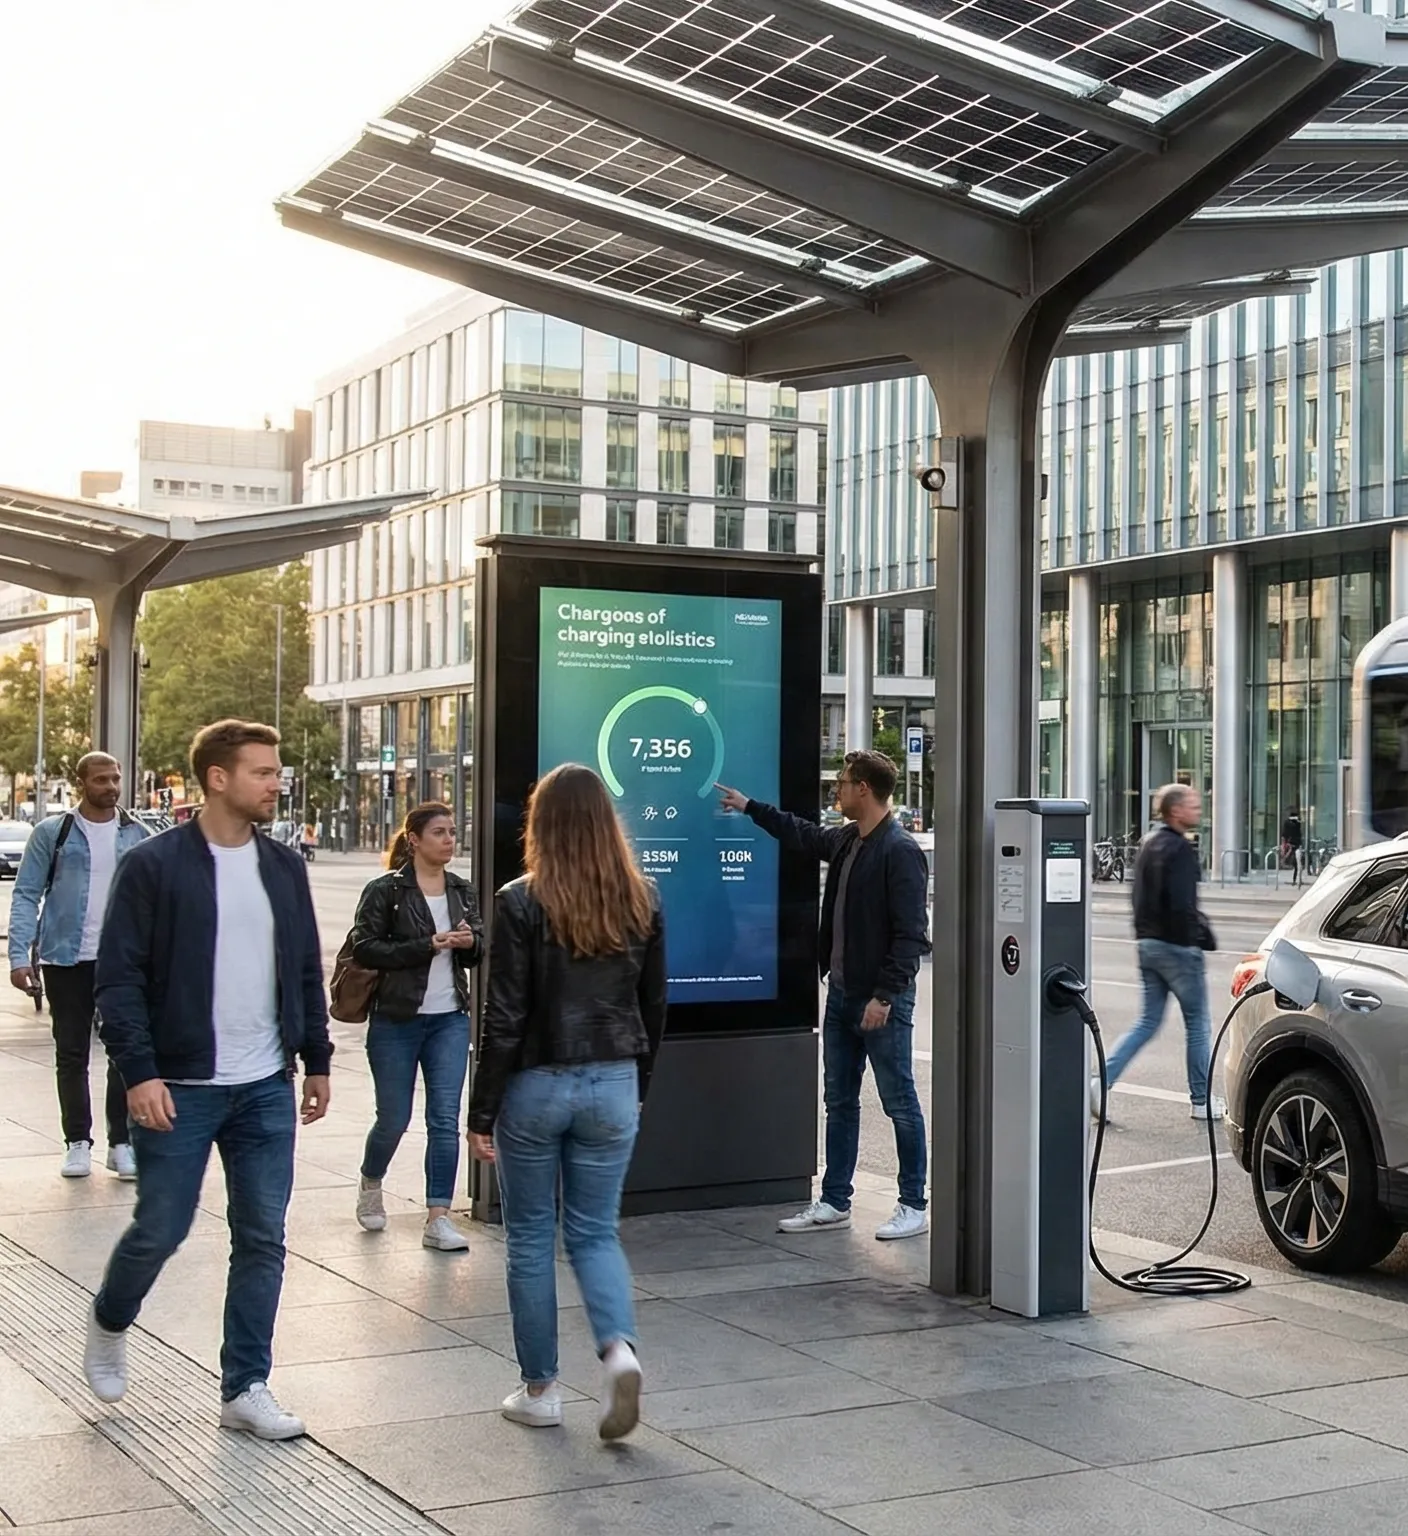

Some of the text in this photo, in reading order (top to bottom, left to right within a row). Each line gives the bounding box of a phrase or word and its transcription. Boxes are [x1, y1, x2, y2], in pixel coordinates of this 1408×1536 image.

[647, 608, 667, 624] of
[557, 625, 636, 648] charging
[629, 738, 692, 761] 7,356
